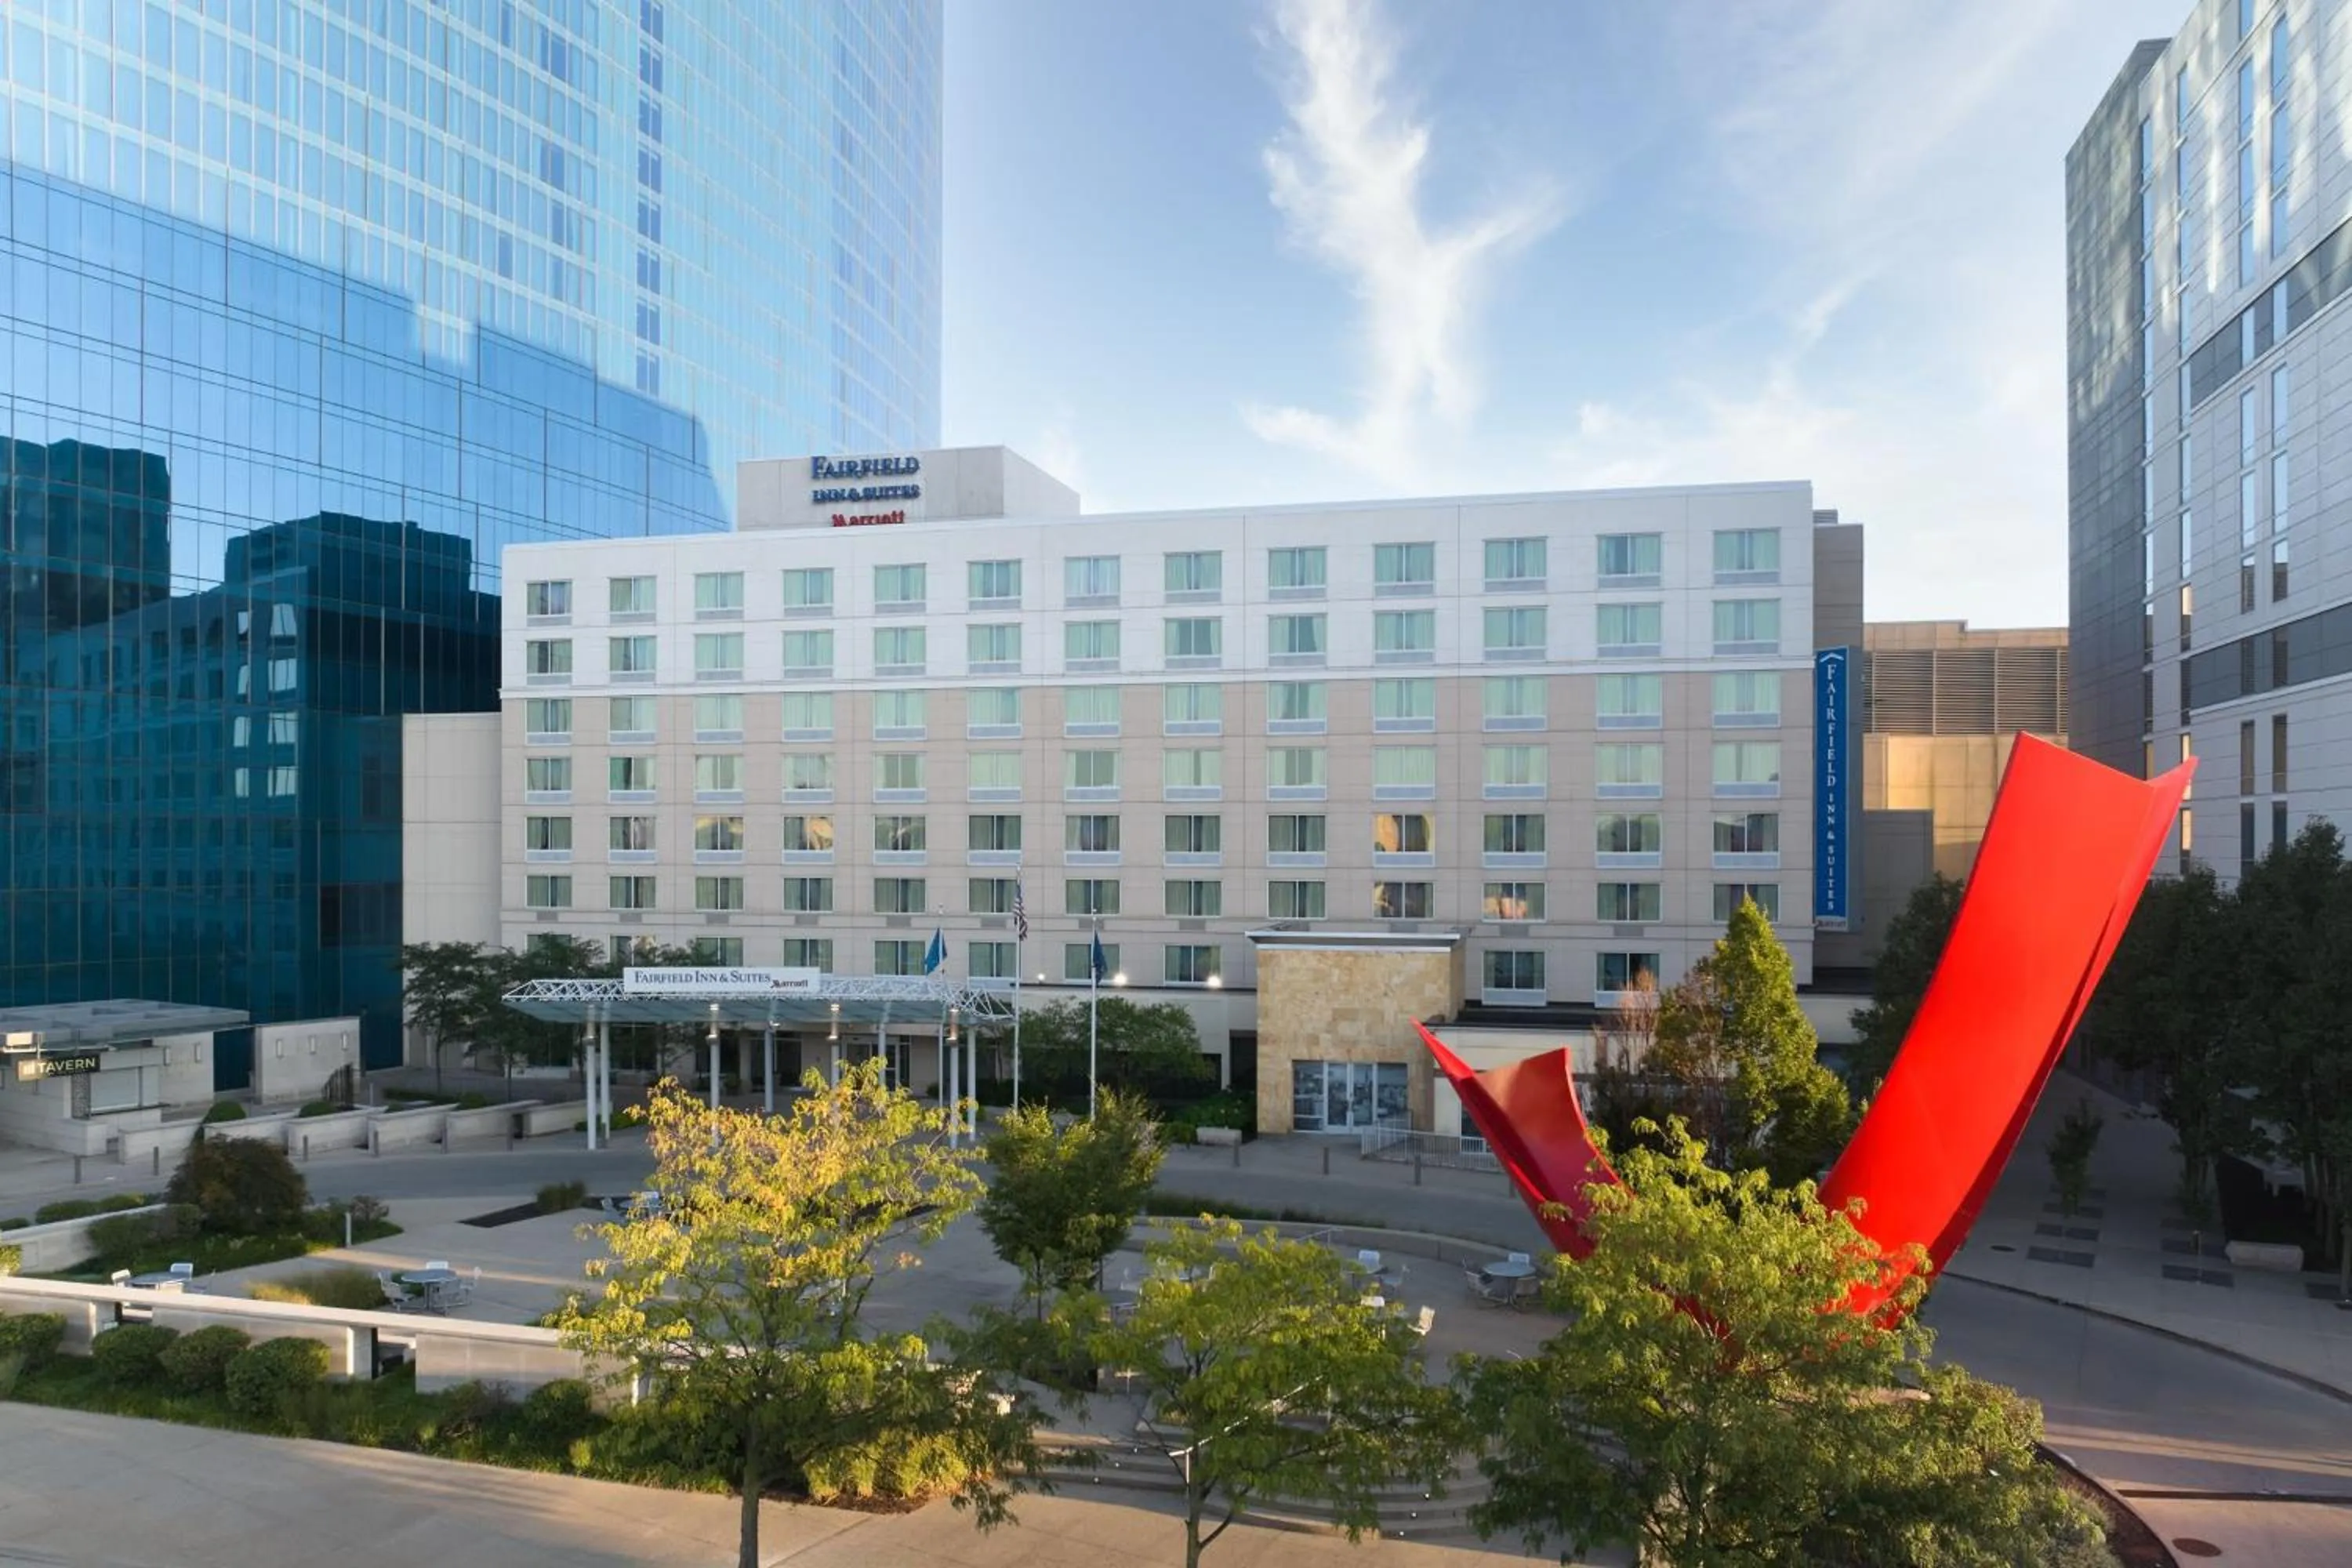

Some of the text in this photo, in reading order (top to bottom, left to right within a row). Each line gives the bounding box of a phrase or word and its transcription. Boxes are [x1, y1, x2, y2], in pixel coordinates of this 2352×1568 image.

[811, 456, 920, 479] FAIRFIELD
[1827, 664, 1837, 787] FAIRFIELD
[634, 971, 693, 984] FAIRFIELD
[730, 970, 771, 983] SUITES
[38, 1058, 96, 1073] TAVERN
